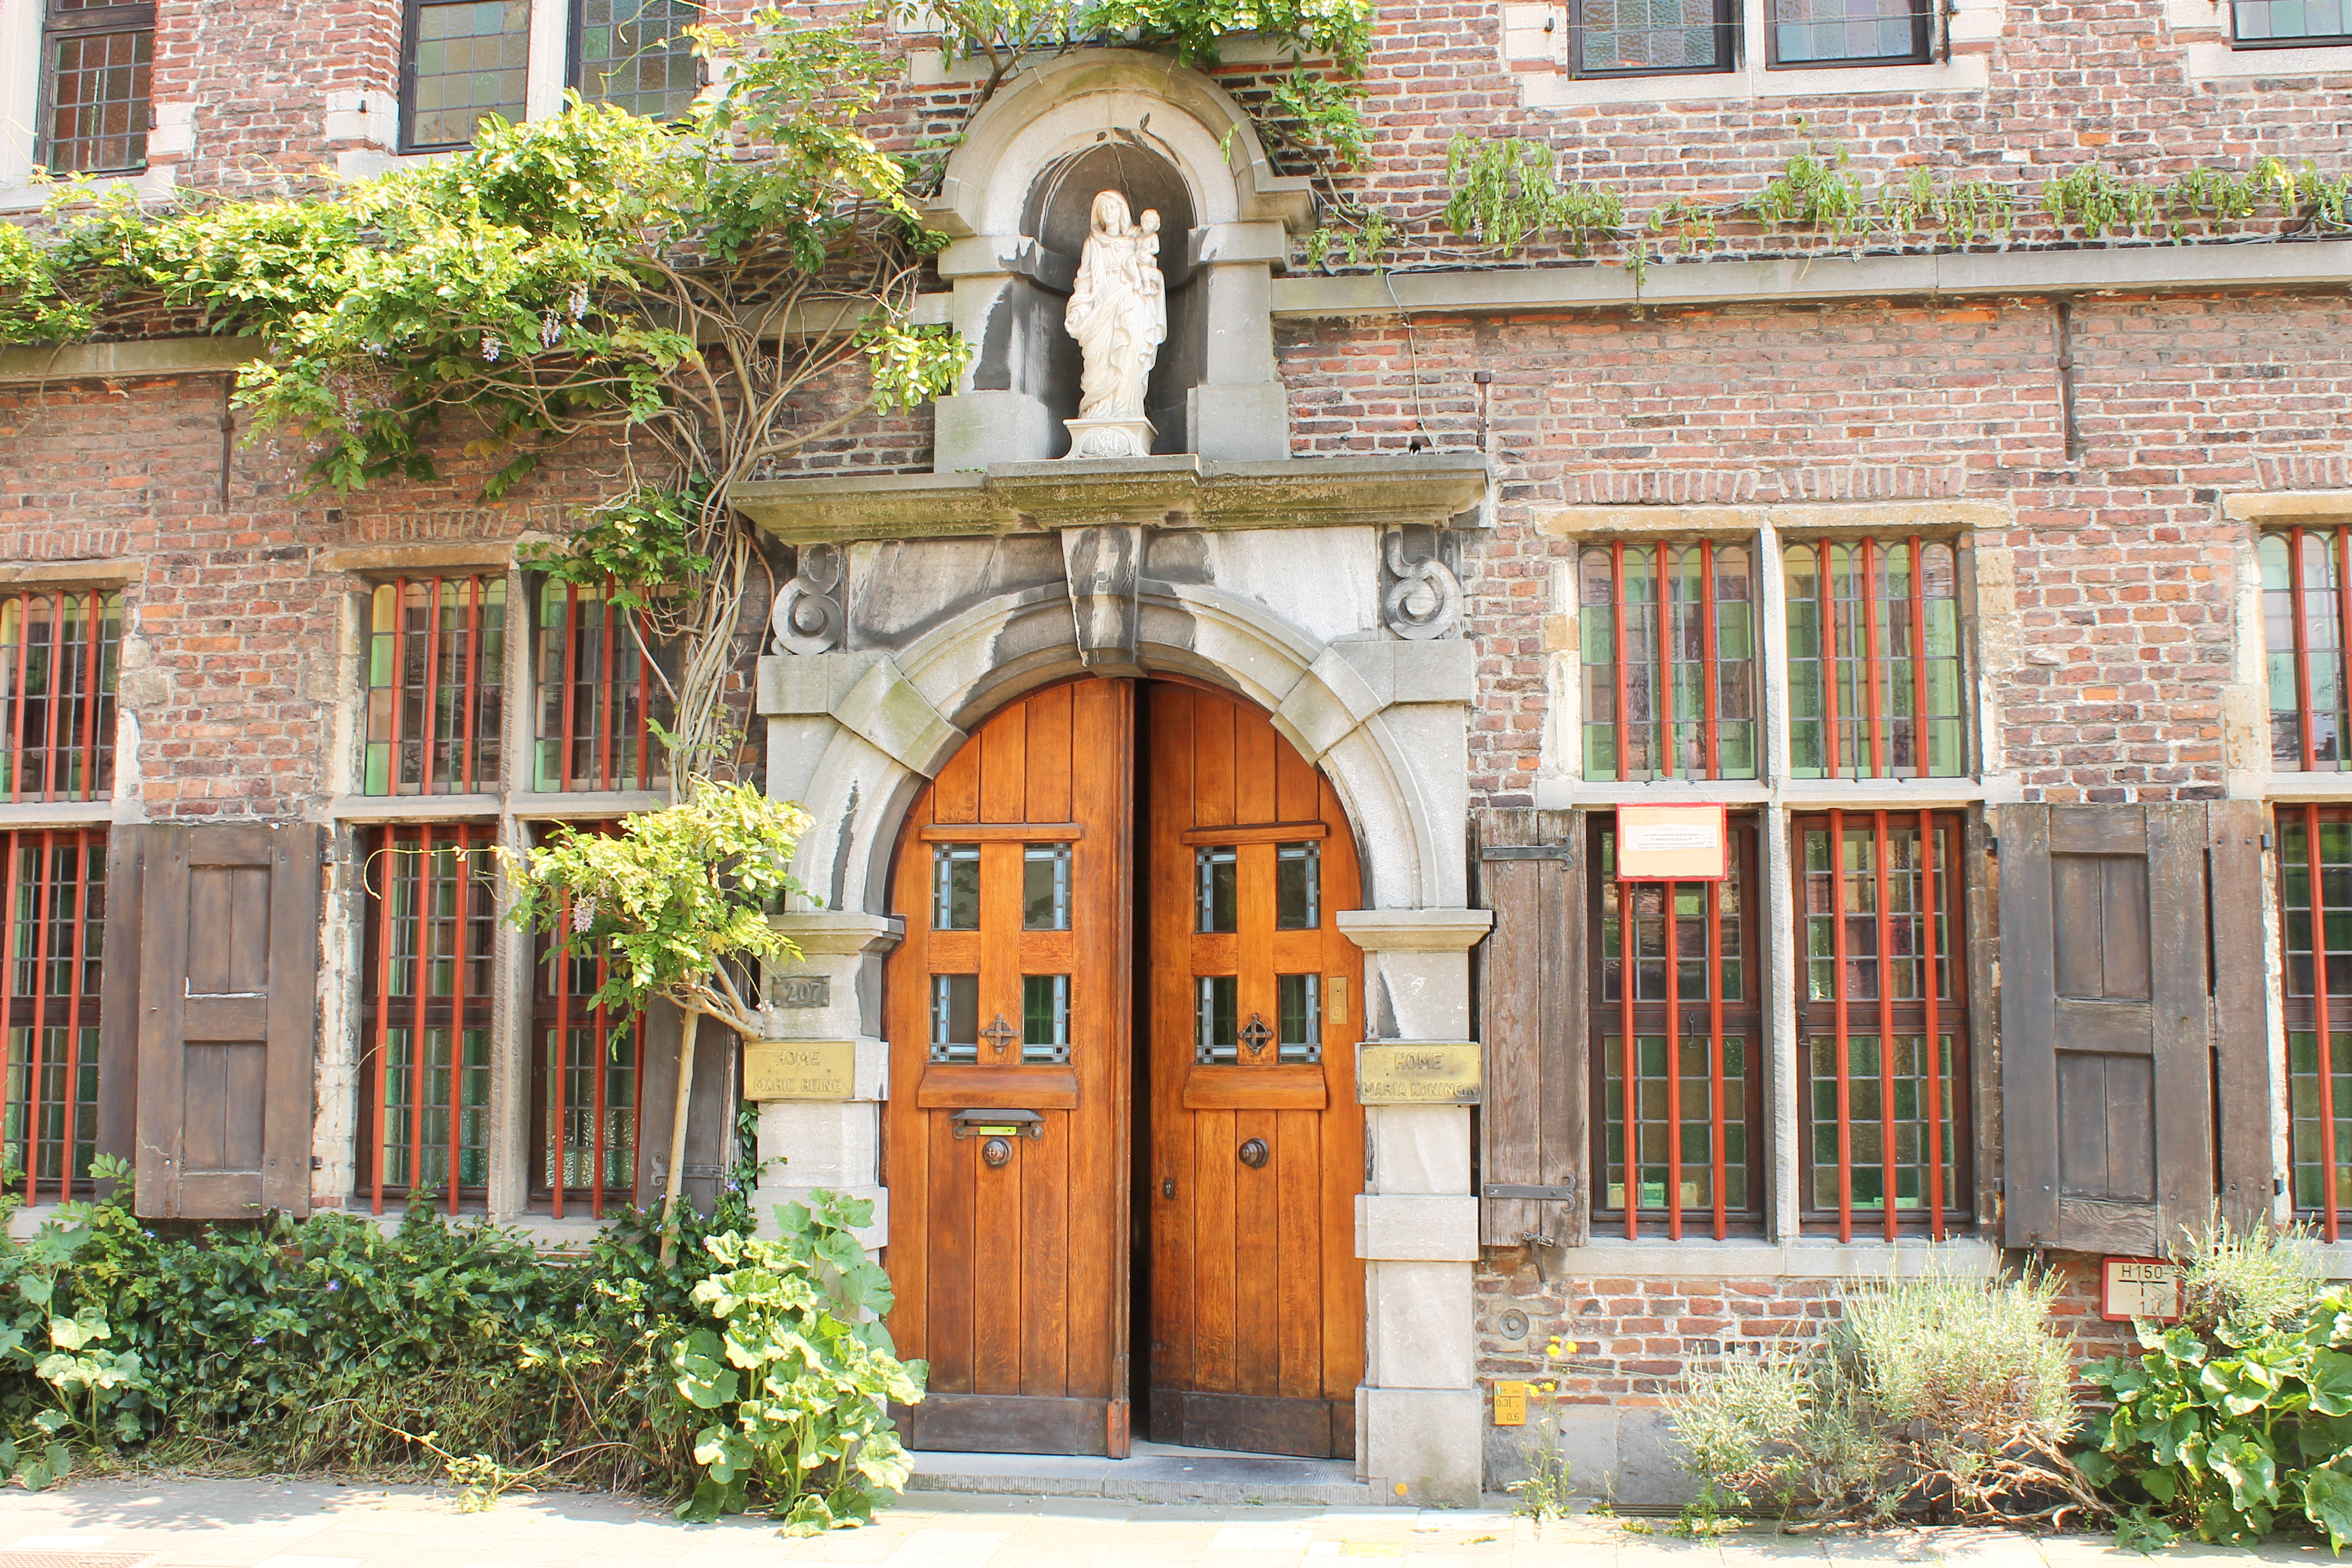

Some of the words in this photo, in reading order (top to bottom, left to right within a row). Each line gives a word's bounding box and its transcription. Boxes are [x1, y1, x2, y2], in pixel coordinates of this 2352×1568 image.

[785, 982, 822, 1002] 207
[776, 1049, 820, 1066] HOME
[1394, 1052, 1443, 1070] HOME
[754, 1077, 796, 1092] MARIE
[801, 1078, 841, 1092] REINE
[1363, 1082, 1407, 1097] MARIA
[1411, 1082, 1478, 1097] KONINGIN
[1507, 1413, 1520, 1421] 0.6
